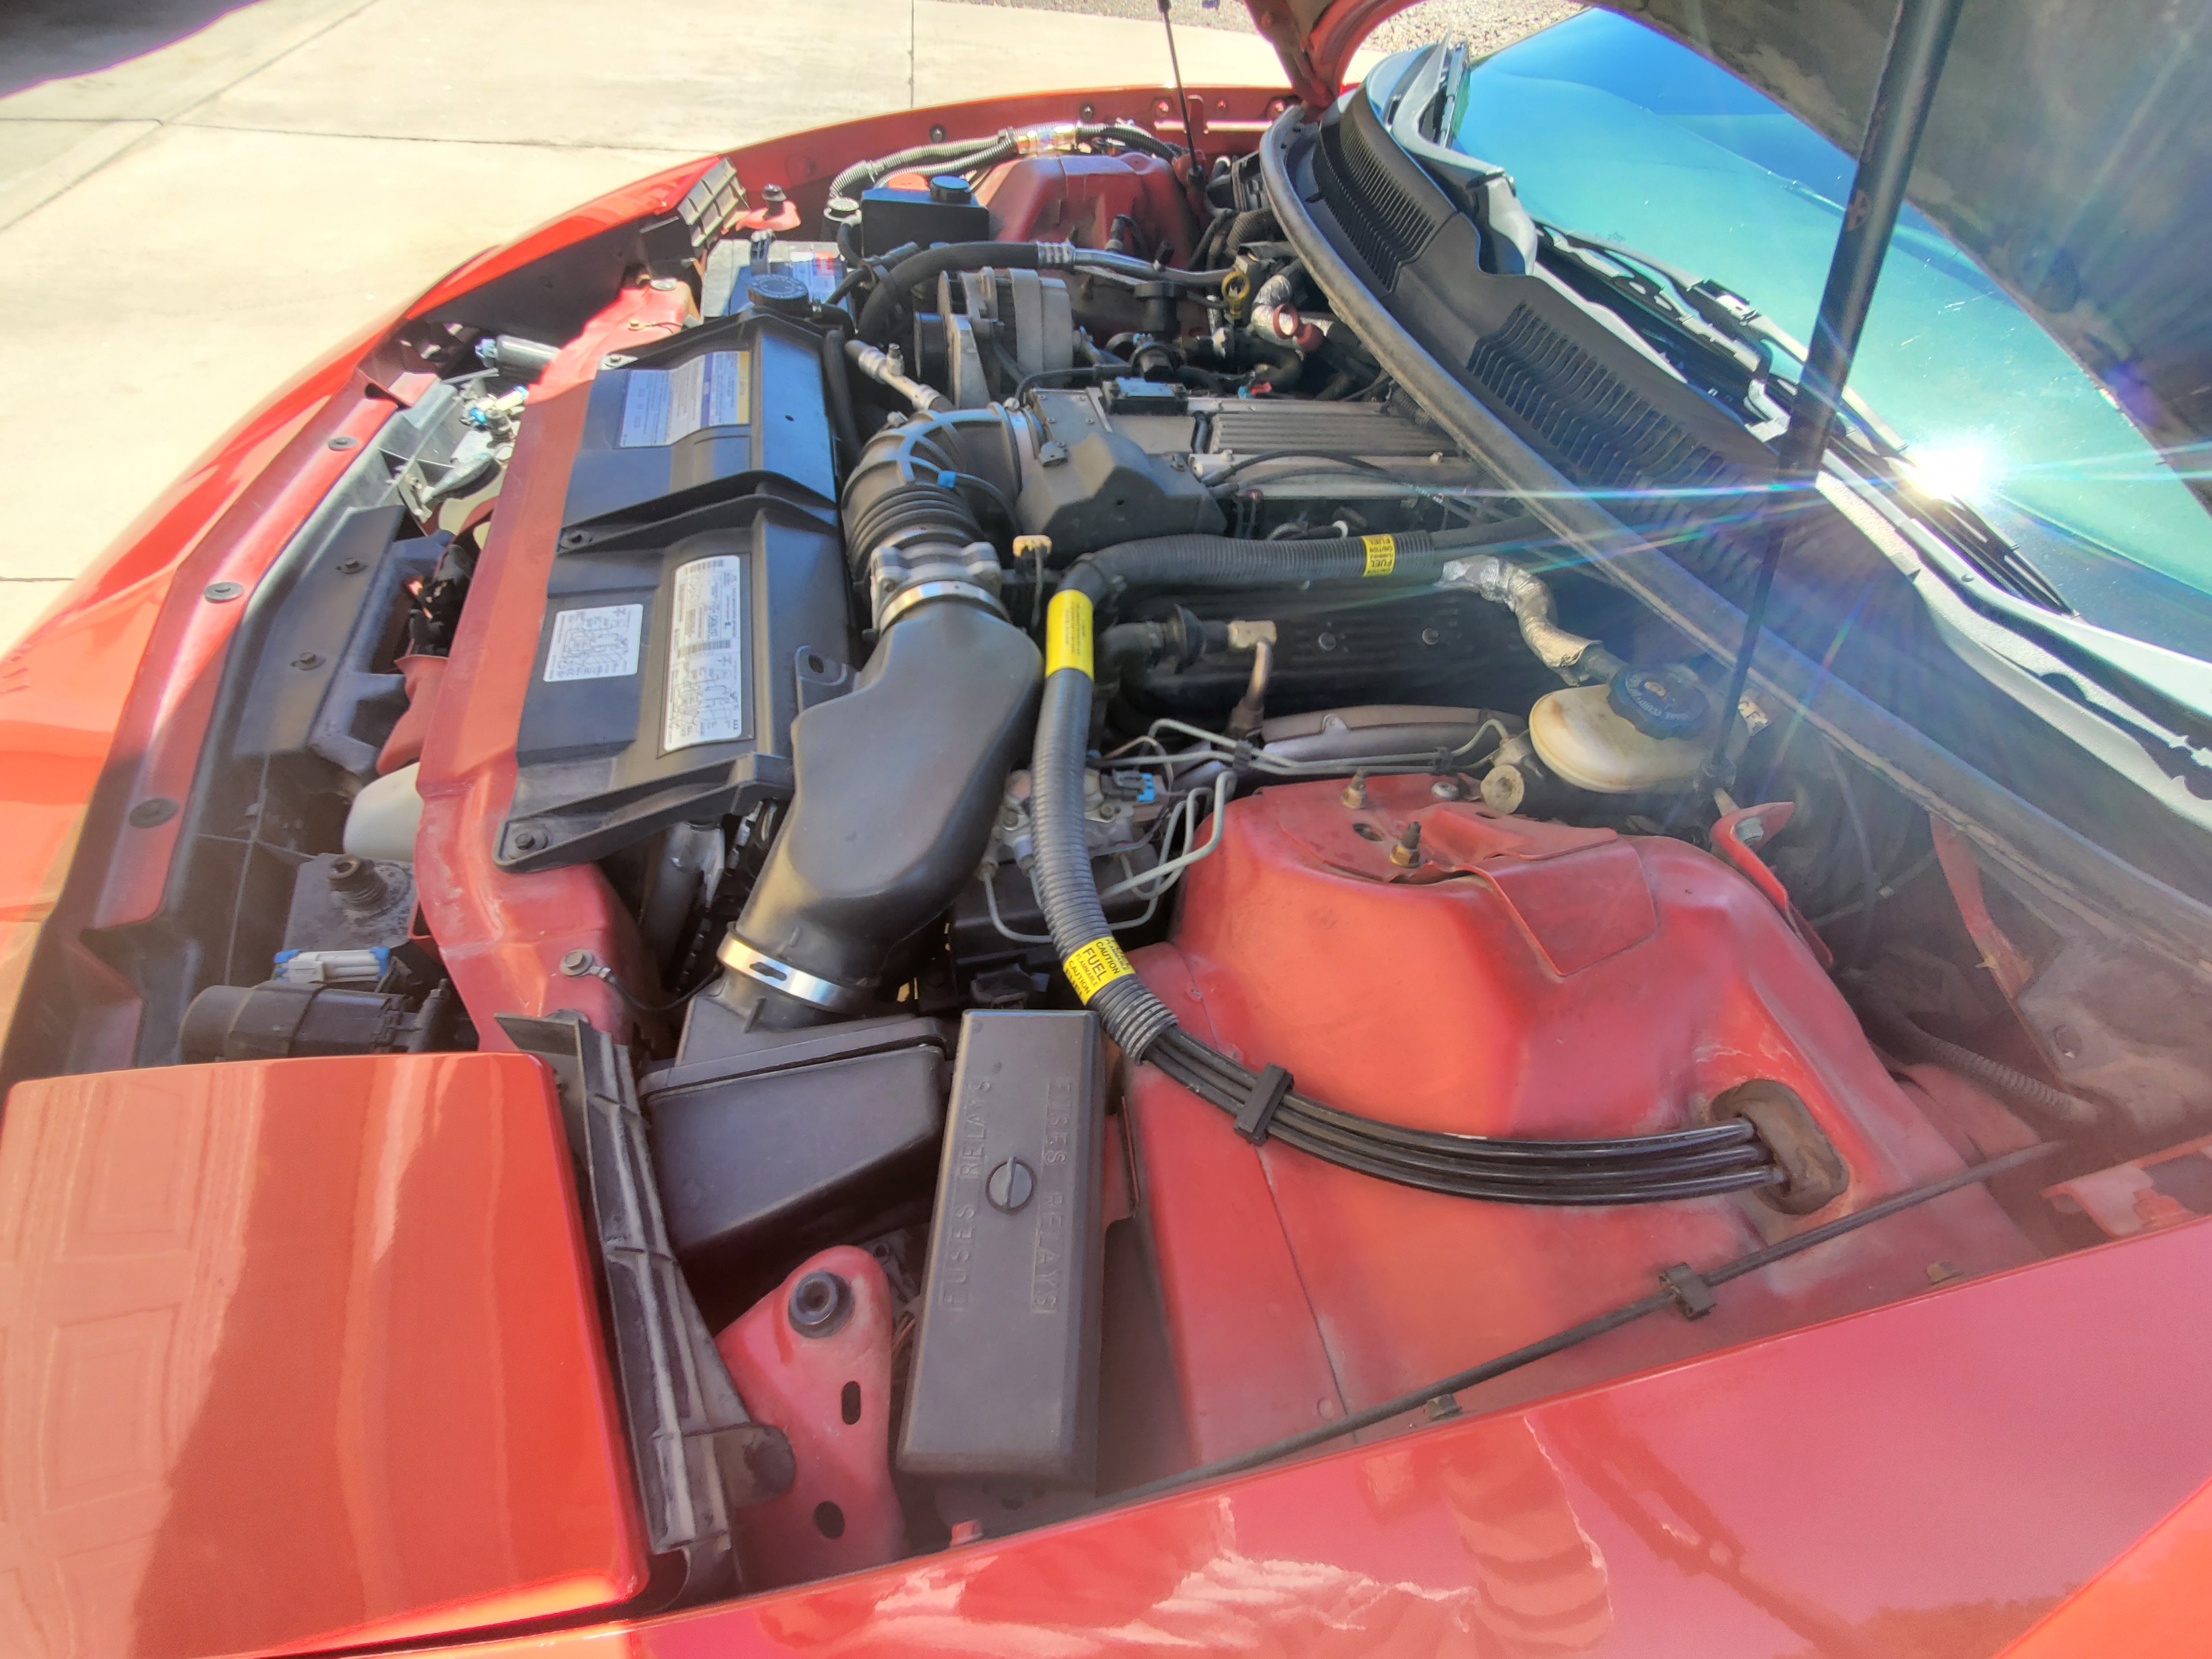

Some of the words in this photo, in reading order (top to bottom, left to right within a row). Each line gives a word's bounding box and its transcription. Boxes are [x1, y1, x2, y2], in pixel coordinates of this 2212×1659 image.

[1075, 954, 1098, 986] FLAMMABLE
[1082, 946, 1107, 982] FUEL
[1096, 941, 1120, 974] CAUTION
[1105, 939, 1127, 970] FLAMMABLE
[1069, 960, 1091, 994] CAUTION
[1045, 1081, 1072, 1166] FUSES
[942, 1205, 976, 1306] FUSES
[960, 1078, 992, 1178] RELAYS
[1033, 1192, 1066, 1310] RELAYS
